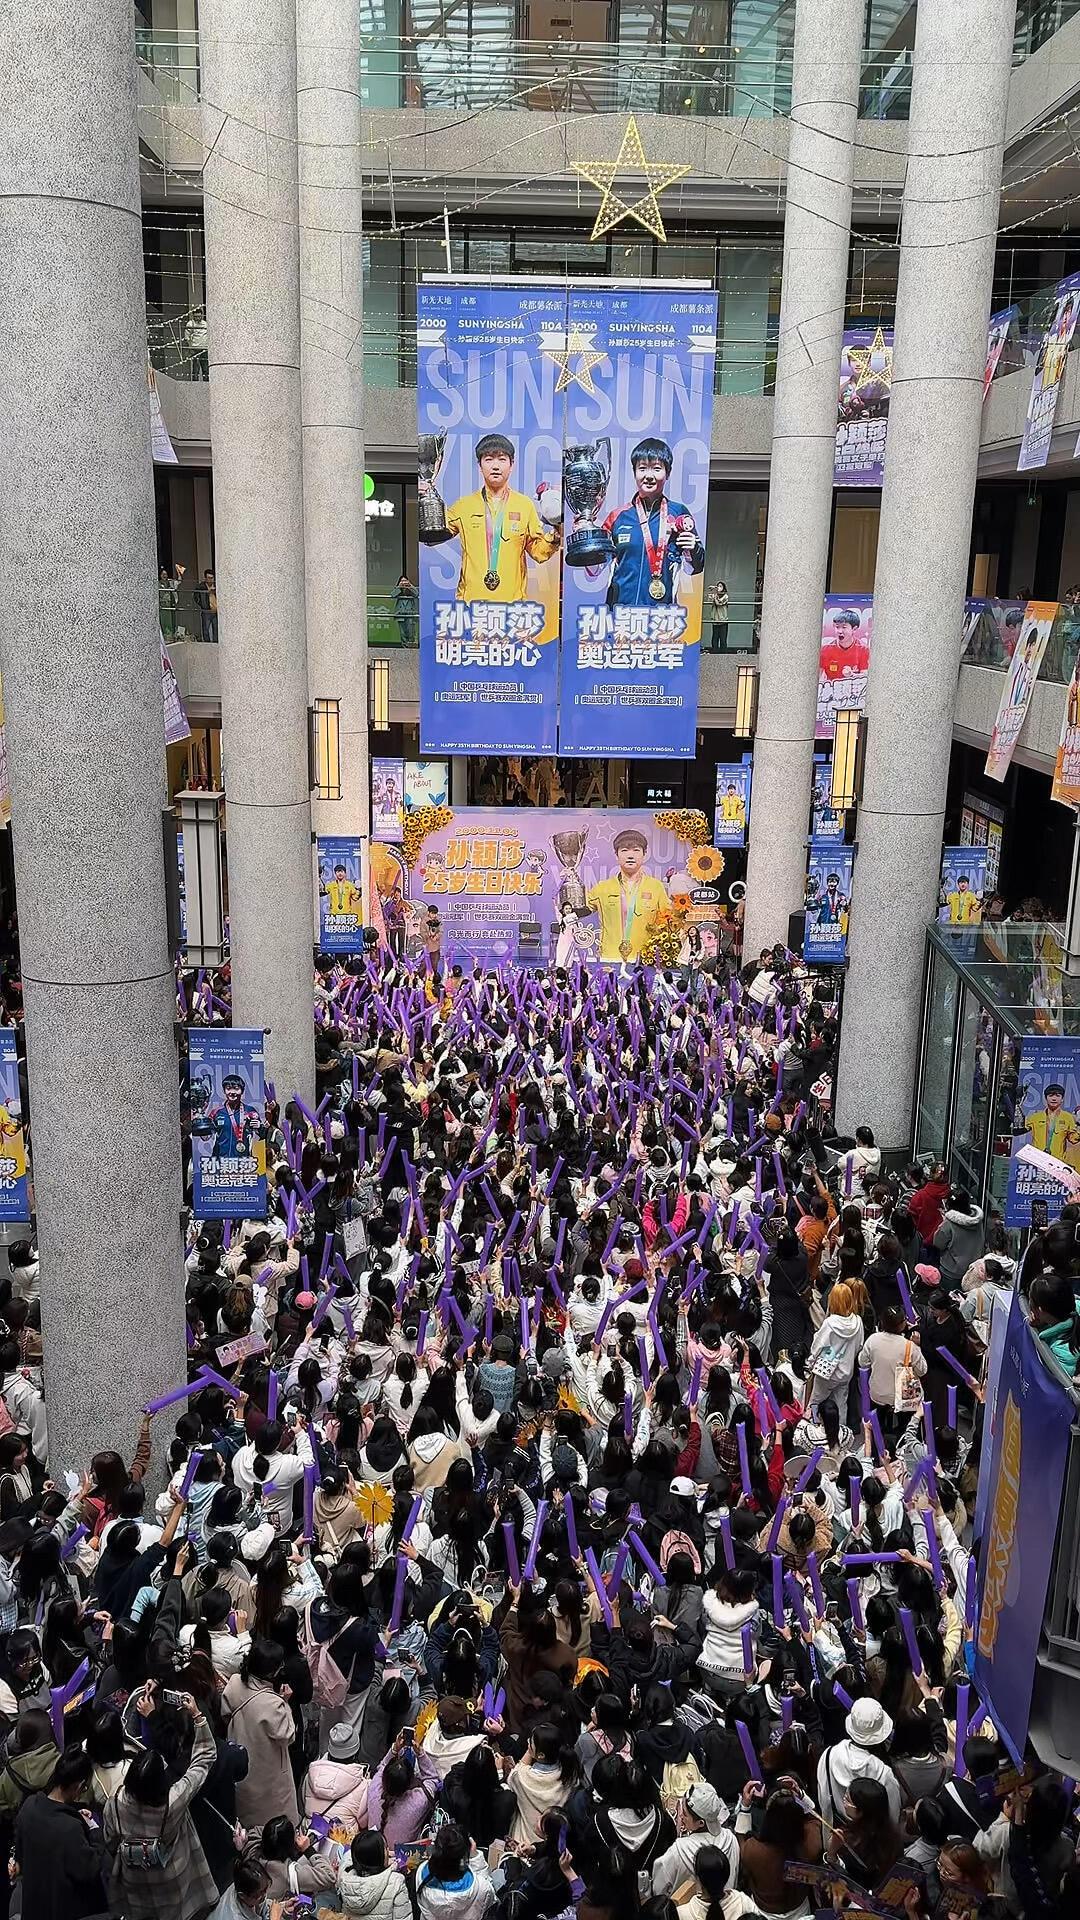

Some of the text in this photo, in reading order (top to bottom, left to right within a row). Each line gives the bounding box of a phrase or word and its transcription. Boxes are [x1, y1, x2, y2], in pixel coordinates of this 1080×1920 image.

[460, 297, 477, 305] 成都
[612, 301, 628, 309] 成都
[420, 318, 563, 331] 2000 SUNYINGSHA 1104
[609, 323, 676, 333] SUNYINGSHA
[692, 325, 713, 333] 1104
[426, 349, 553, 429] SUN
[574, 352, 704, 433] SUN
[435, 602, 543, 639] 孙颖莎
[578, 606, 688, 641] 孙颖莎
[435, 639, 542, 667] 明亮的心
[577, 643, 684, 669] 奥运冠军
[445, 839, 526, 869] 孙颖莎
[423, 871, 543, 896] 25岁生日快乐
[201, 1156, 258, 1174] 孙颖莎
[201, 1174, 259, 1188] 奥运冠军
